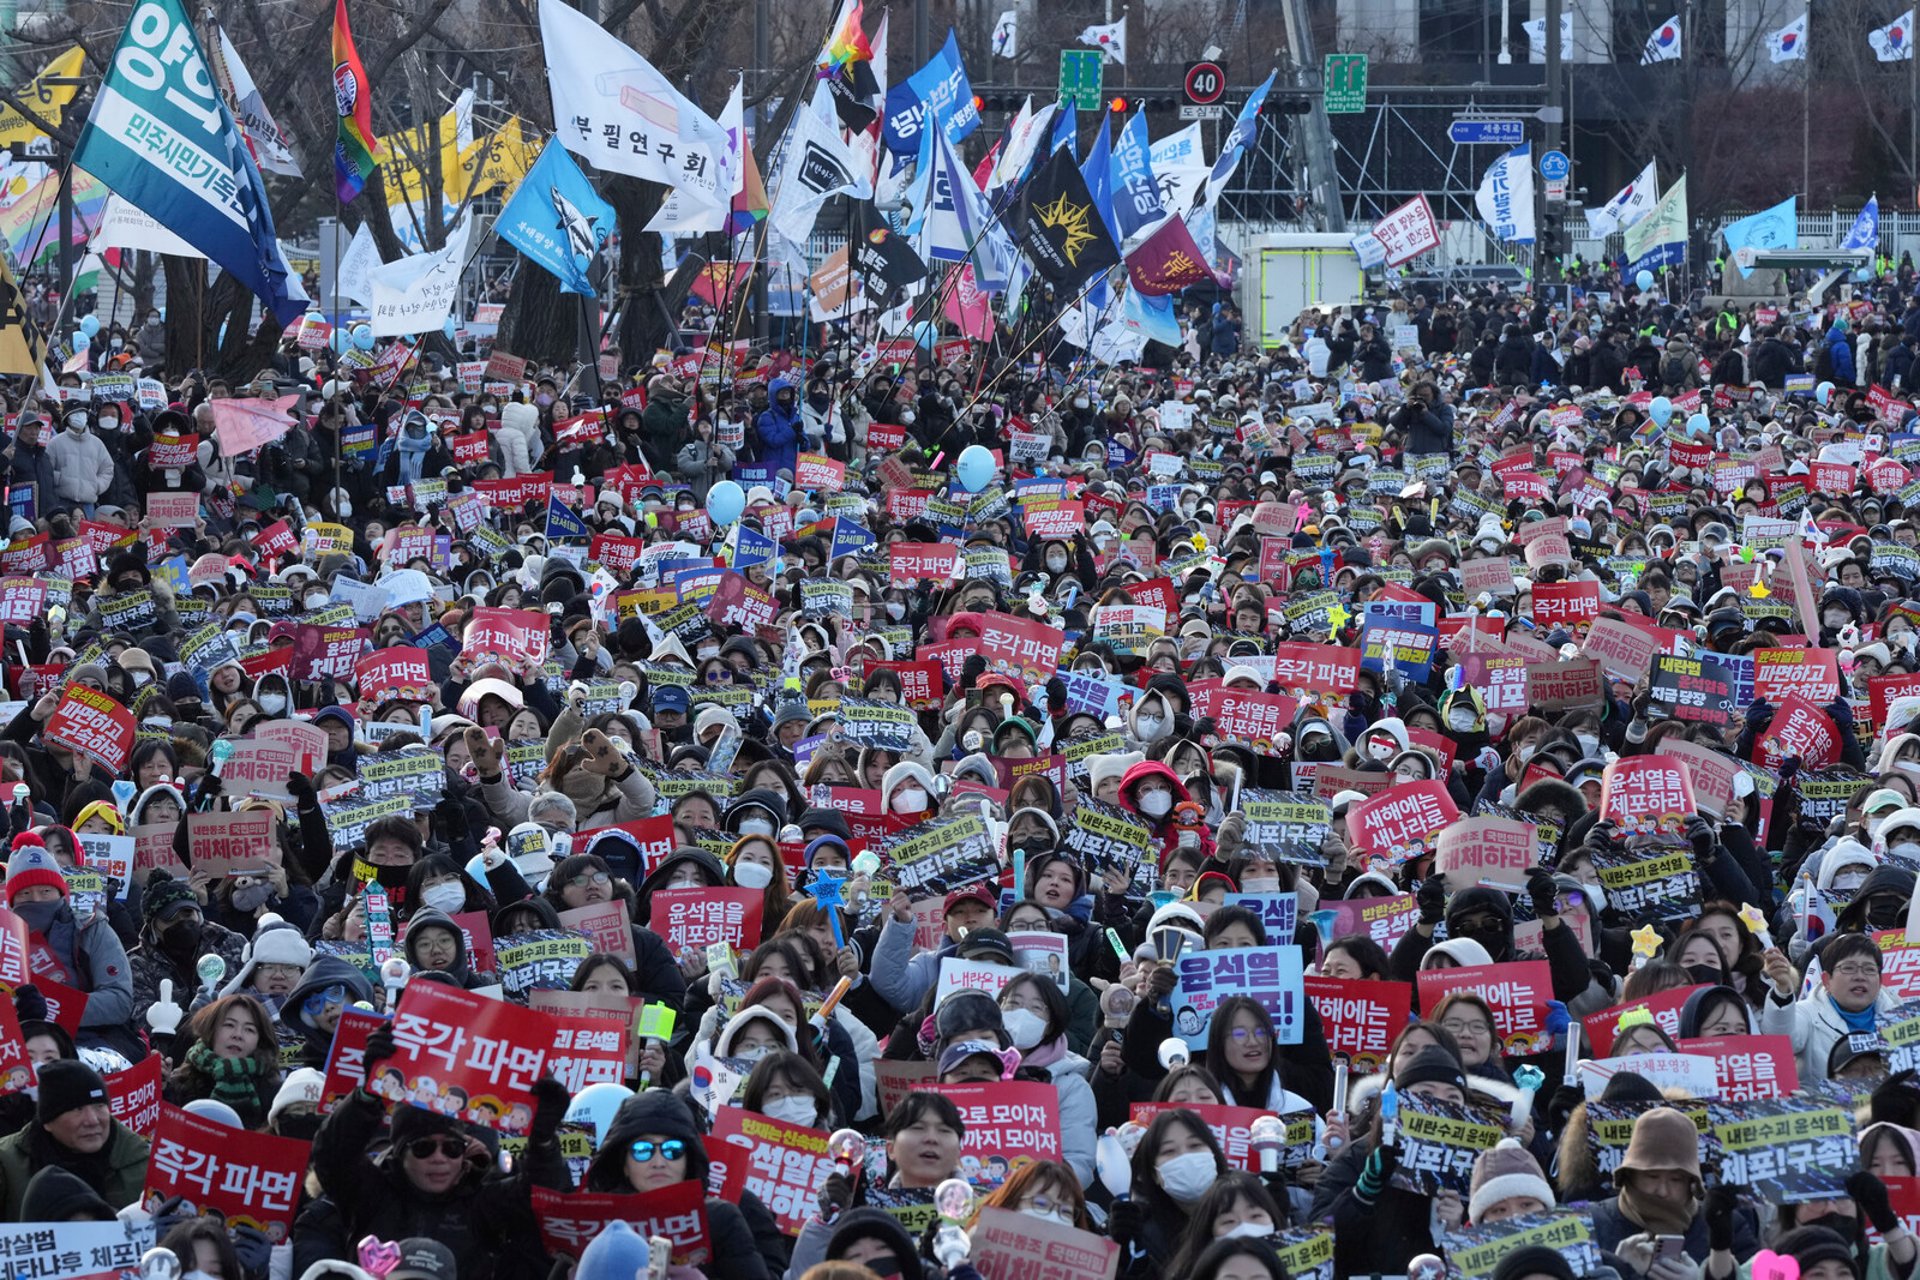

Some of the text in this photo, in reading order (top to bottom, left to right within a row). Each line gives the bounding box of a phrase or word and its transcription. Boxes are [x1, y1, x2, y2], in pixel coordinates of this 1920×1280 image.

[1194, 74, 1216, 93] 40
[1182, 107, 1222, 117] 도심부
[1479, 134, 1520, 142] Sejong-daero
[1483, 124, 1520, 133] 세종대로
[151, 442, 189, 453] 파면하고
[869, 432, 903, 447] 즉각 파면
[455, 446, 473, 459] 즉각
[1671, 448, 1710, 465] 즉각 파면
[797, 462, 837, 479] 파면하고
[1715, 468, 1756, 480] 국민의힘
[1816, 469, 1849, 480] 윤석열을
[1872, 468, 1903, 478] 윤석열을
[1151, 486, 1182, 500] 윤석열
[1505, 480, 1527, 494] 즉각
[1816, 479, 1849, 491] 체포하라
[499, 488, 522, 502] 파면
[149, 506, 196, 517] 해체하라
[764, 514, 792, 525] 윤석열
[1028, 510, 1074, 523] 파면하고
[551, 516, 579, 533] 강서(을)
[680, 516, 707, 530] 윤석열
[271, 531, 295, 550] 파면
[401, 536, 432, 547] 윤석열
[600, 542, 636, 556] 윤석열을
[837, 534, 866, 545] 강서(을)
[2, 544, 43, 561] 파면하고
[62, 543, 91, 561] 윤석열
[390, 547, 431, 565] 체포!
[600, 553, 634, 568] 체포하라
[55, 559, 96, 578] 체포!
[893, 556, 953, 574] 즉각 파면
[1466, 573, 1512, 587] 해체하라
[5, 587, 41, 599] 윤석열
[743, 587, 769, 603] 반란수괴
[101, 593, 147, 614] 내란수괴 윤석열
[102, 600, 156, 626] 체포!구속!
[742, 596, 774, 616] 윤석열
[1288, 602, 1314, 617] 내란수괴
[1535, 598, 1599, 618] 즉각 파면
[1746, 608, 1773, 618] 내란수괴
[1099, 609, 1134, 621] 윤석열
[323, 629, 355, 643] 반란수괴
[1099, 623, 1146, 634] 감옥가고
[327, 638, 363, 655] 윤석열
[493, 630, 524, 656] 파면
[983, 627, 1058, 668] 즉각 파면
[1367, 629, 1432, 649] 윤석열을!
[1587, 634, 1649, 672] 해체하라
[1758, 651, 1805, 663] 윤석열을
[307, 652, 359, 681] 체포!
[1486, 658, 1523, 669] 반란수괴
[1659, 657, 1701, 676] 내란범
[359, 659, 428, 690] 즉각 파면
[1276, 659, 1357, 688] 즉각 파면
[1530, 672, 1560, 681] 내란동조
[1757, 665, 1826, 682] 파면하고
[1530, 680, 1599, 700] 해체하라
[1679, 675, 1728, 696] 윤석열을
[67, 686, 115, 714] 윤석열을
[1651, 686, 1706, 706] 지금 당장
[58, 701, 127, 741] 파면하고
[849, 707, 911, 722] 내란수괴 윤석열
[1220, 702, 1280, 722] 윤석열을
[844, 721, 915, 740] 체포!구속!
[1218, 718, 1278, 740] 체포하라
[60, 720, 125, 765] 구속하라!
[257, 749, 295, 764] 국민의힘
[367, 757, 437, 779] 내란수괴 윤석열
[1012, 759, 1051, 775] 반란수괴
[662, 782, 696, 794] 내란수괴
[1608, 768, 1683, 794] 윤석열을
[1805, 784, 1840, 796] 내란수괴
[1250, 804, 1325, 820] 내란수괴 윤석열
[1364, 792, 1439, 830] 새해에는
[1608, 790, 1687, 815] 체포하라
[192, 814, 269, 837] 내란동조 국민의힘
[334, 805, 372, 827] 내란수괴
[1081, 808, 1146, 846] 내란수괴 윤석열
[1242, 825, 1329, 846] 체포!구속!
[1372, 807, 1448, 851] 새나라로
[897, 818, 976, 863] 내란수괴 윤석열
[1484, 829, 1529, 846] 국민의힘
[192, 835, 271, 861] 해체하라
[900, 835, 990, 889] 체포!구속!
[1604, 856, 1684, 884] 내란수괴 윤석열
[66, 878, 96, 890] 윤석열
[1607, 879, 1694, 910] 체포!구속!
[668, 901, 745, 924] 윤석열을
[1361, 898, 1414, 921] 반란수괴
[581, 916, 621, 931] 국민의힘
[667, 925, 745, 949] 체포하라
[504, 942, 582, 966] 내란수괴 윤석열
[1180, 952, 1279, 992] 윤석열
[950, 972, 993, 992] 내란은
[575, 1029, 621, 1052] 윤석열
[392, 1013, 545, 1092] 즉각 파면
[992, 1103, 1048, 1128] 모이자
[742, 1118, 782, 1141] 헌재는
[1408, 1117, 1498, 1147] 내란수괴 윤석열
[1726, 1114, 1841, 1145] 내란수괴 윤석열
[1006, 1129, 1057, 1155] 모이자
[1721, 1142, 1852, 1185] 체포!구속!
[154, 1138, 297, 1211] 즉각 파면
[91, 1242, 144, 1270] 체포!
[985, 1231, 1106, 1270] 내란동조 국민의힘
[1297, 1239, 1331, 1267] 윤석열
